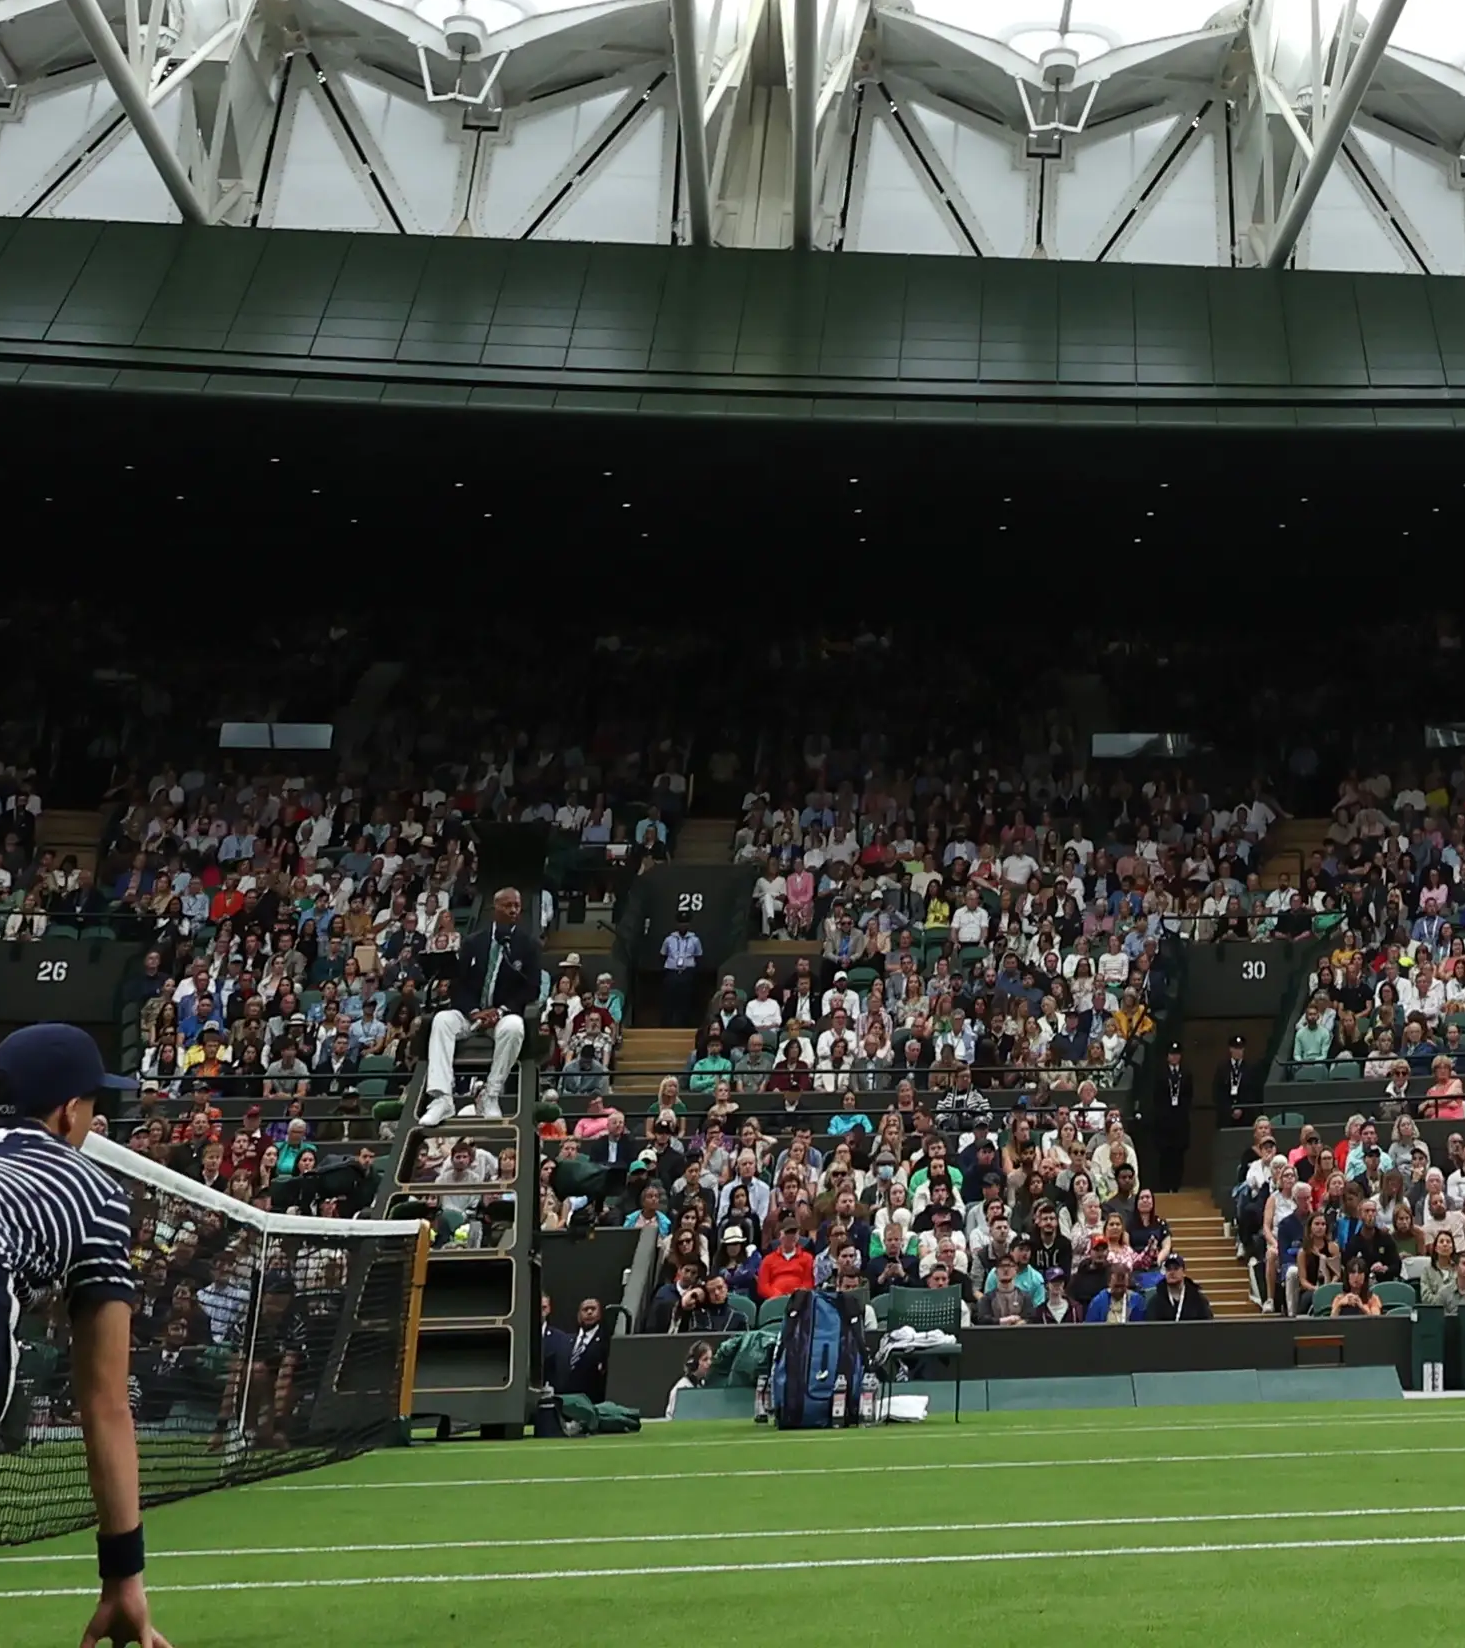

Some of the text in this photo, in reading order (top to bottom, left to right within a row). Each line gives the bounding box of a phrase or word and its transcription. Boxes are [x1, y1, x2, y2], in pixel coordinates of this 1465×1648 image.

[678, 893, 703, 911] 28
[37, 961, 68, 981] 26
[1242, 960, 1266, 979] 30
